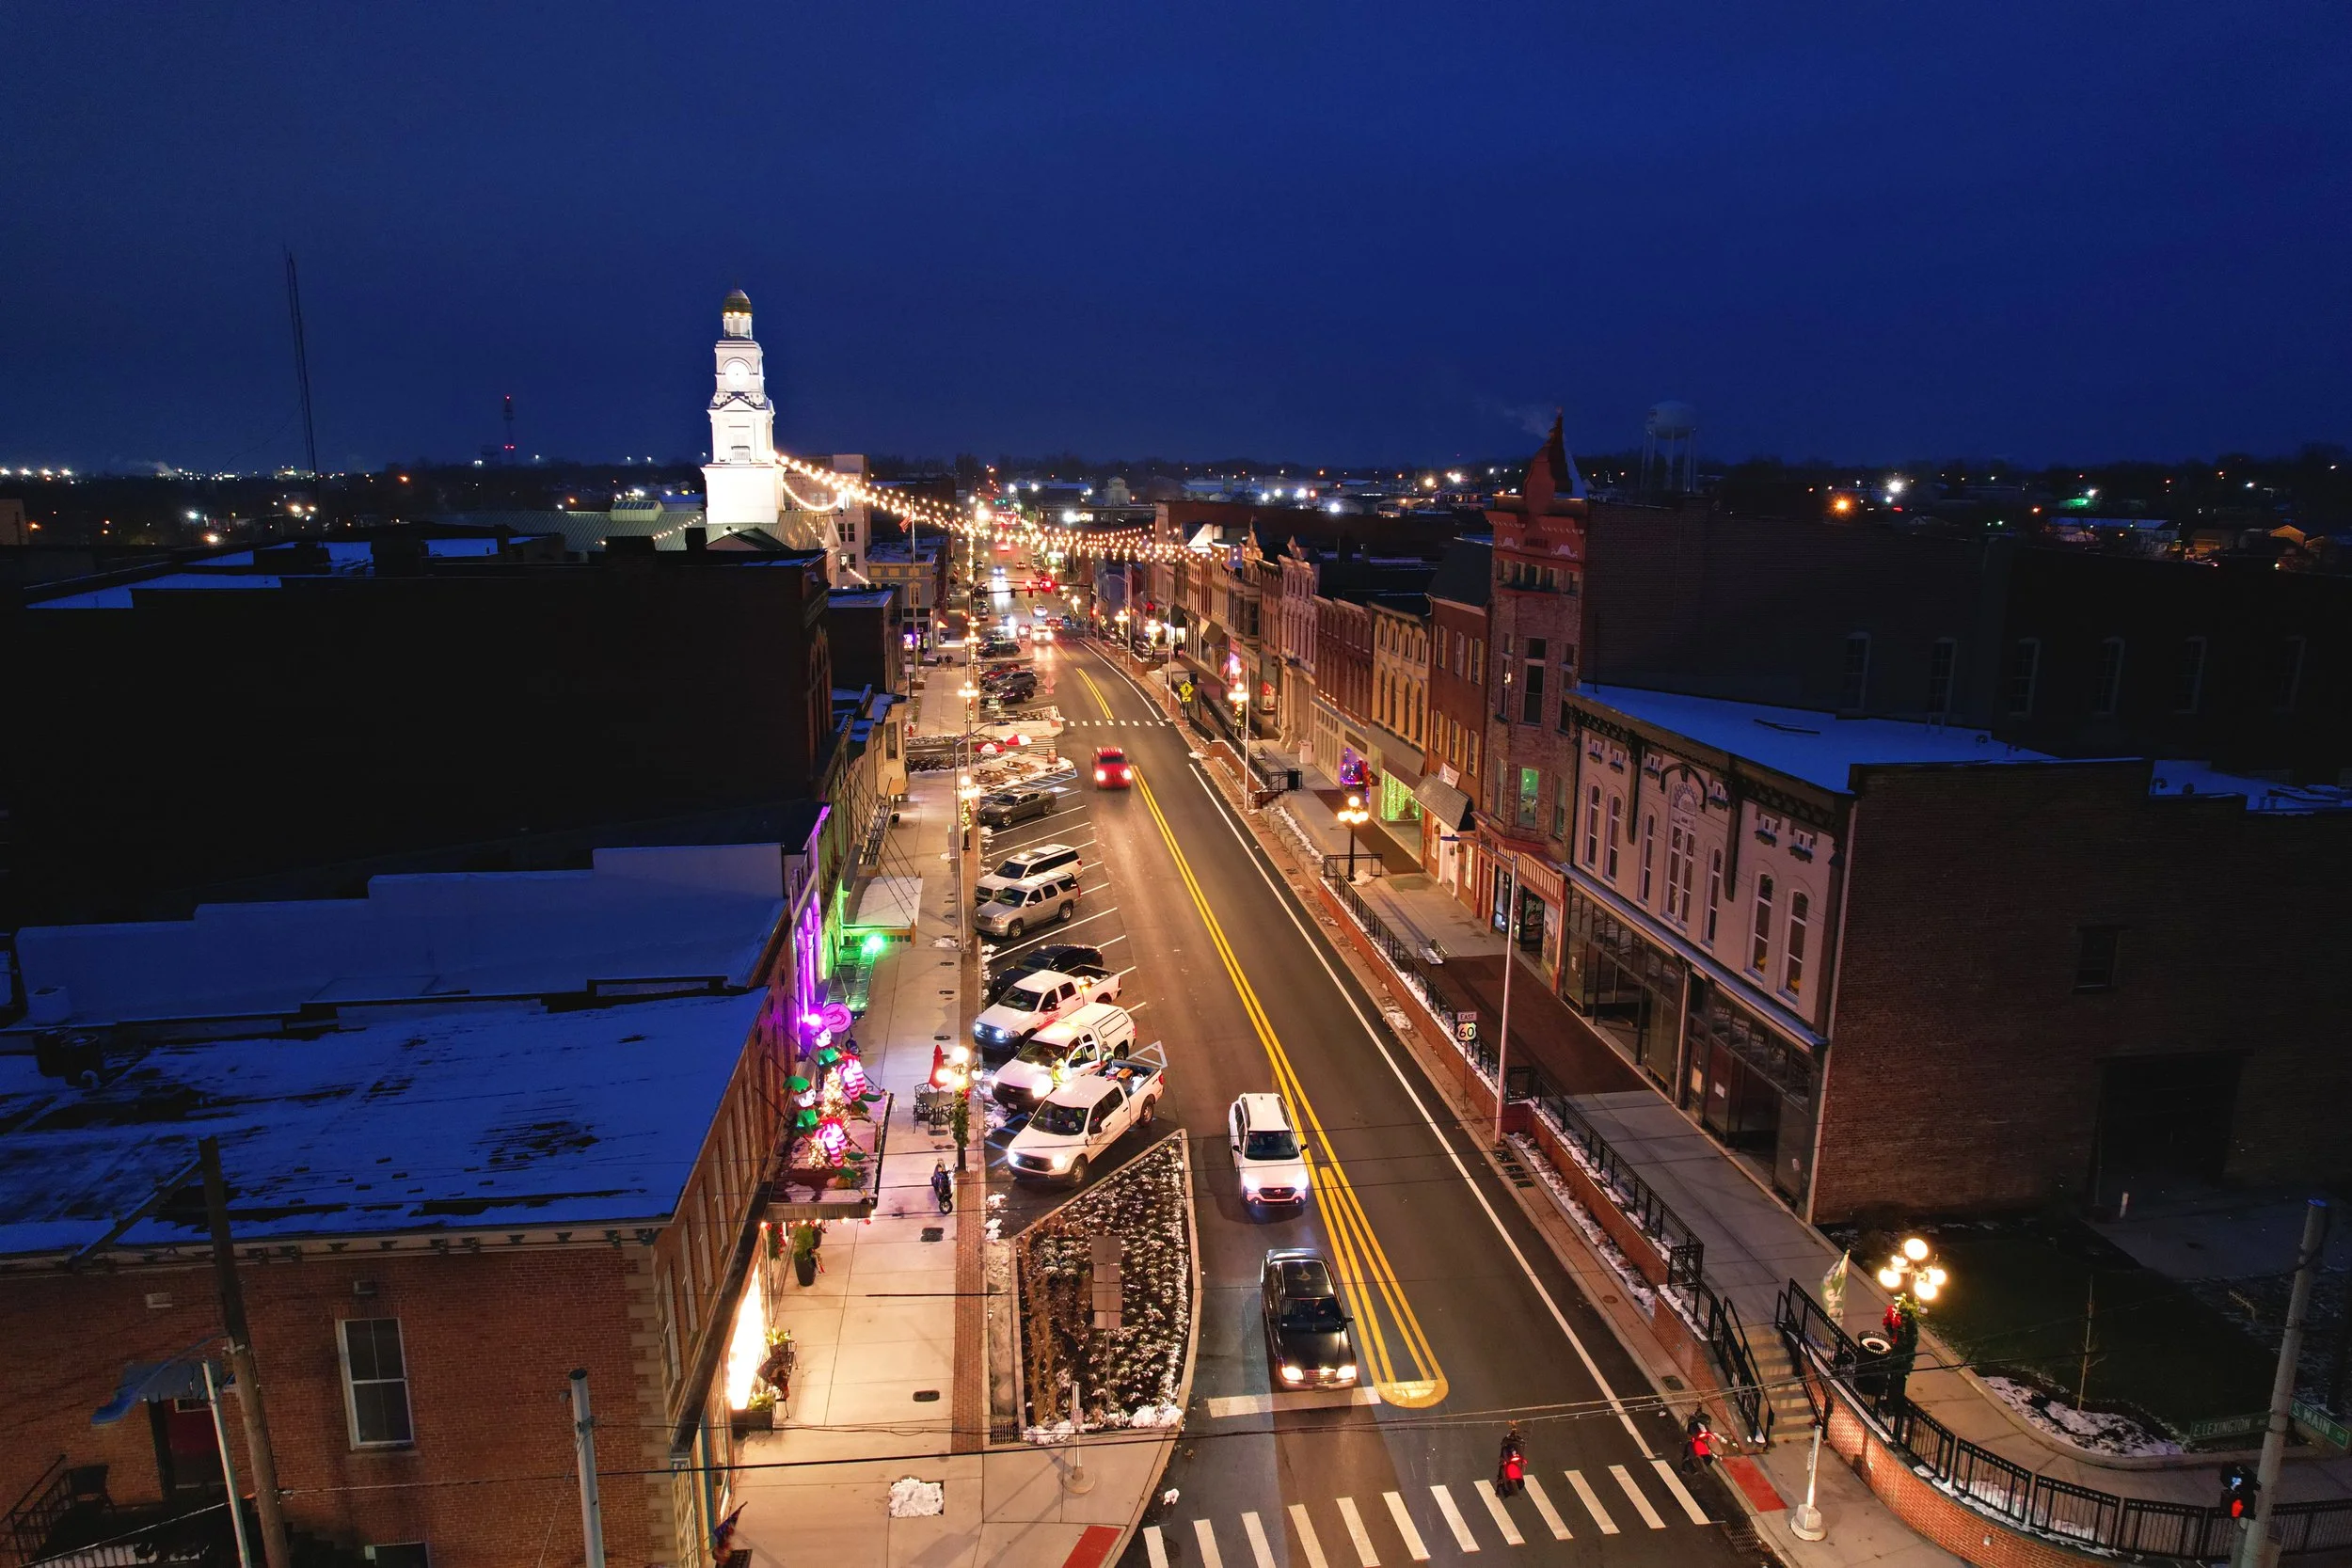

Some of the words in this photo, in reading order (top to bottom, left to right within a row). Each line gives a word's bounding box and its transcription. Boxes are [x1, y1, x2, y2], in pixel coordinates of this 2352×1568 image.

[1459, 1027, 1474, 1037] 60
[2193, 1423, 2201, 1437] E
[2201, 1418, 2251, 1435] LEXINGTON
[2293, 1402, 2300, 1417] S
[2303, 1407, 2331, 1435] MAIN
